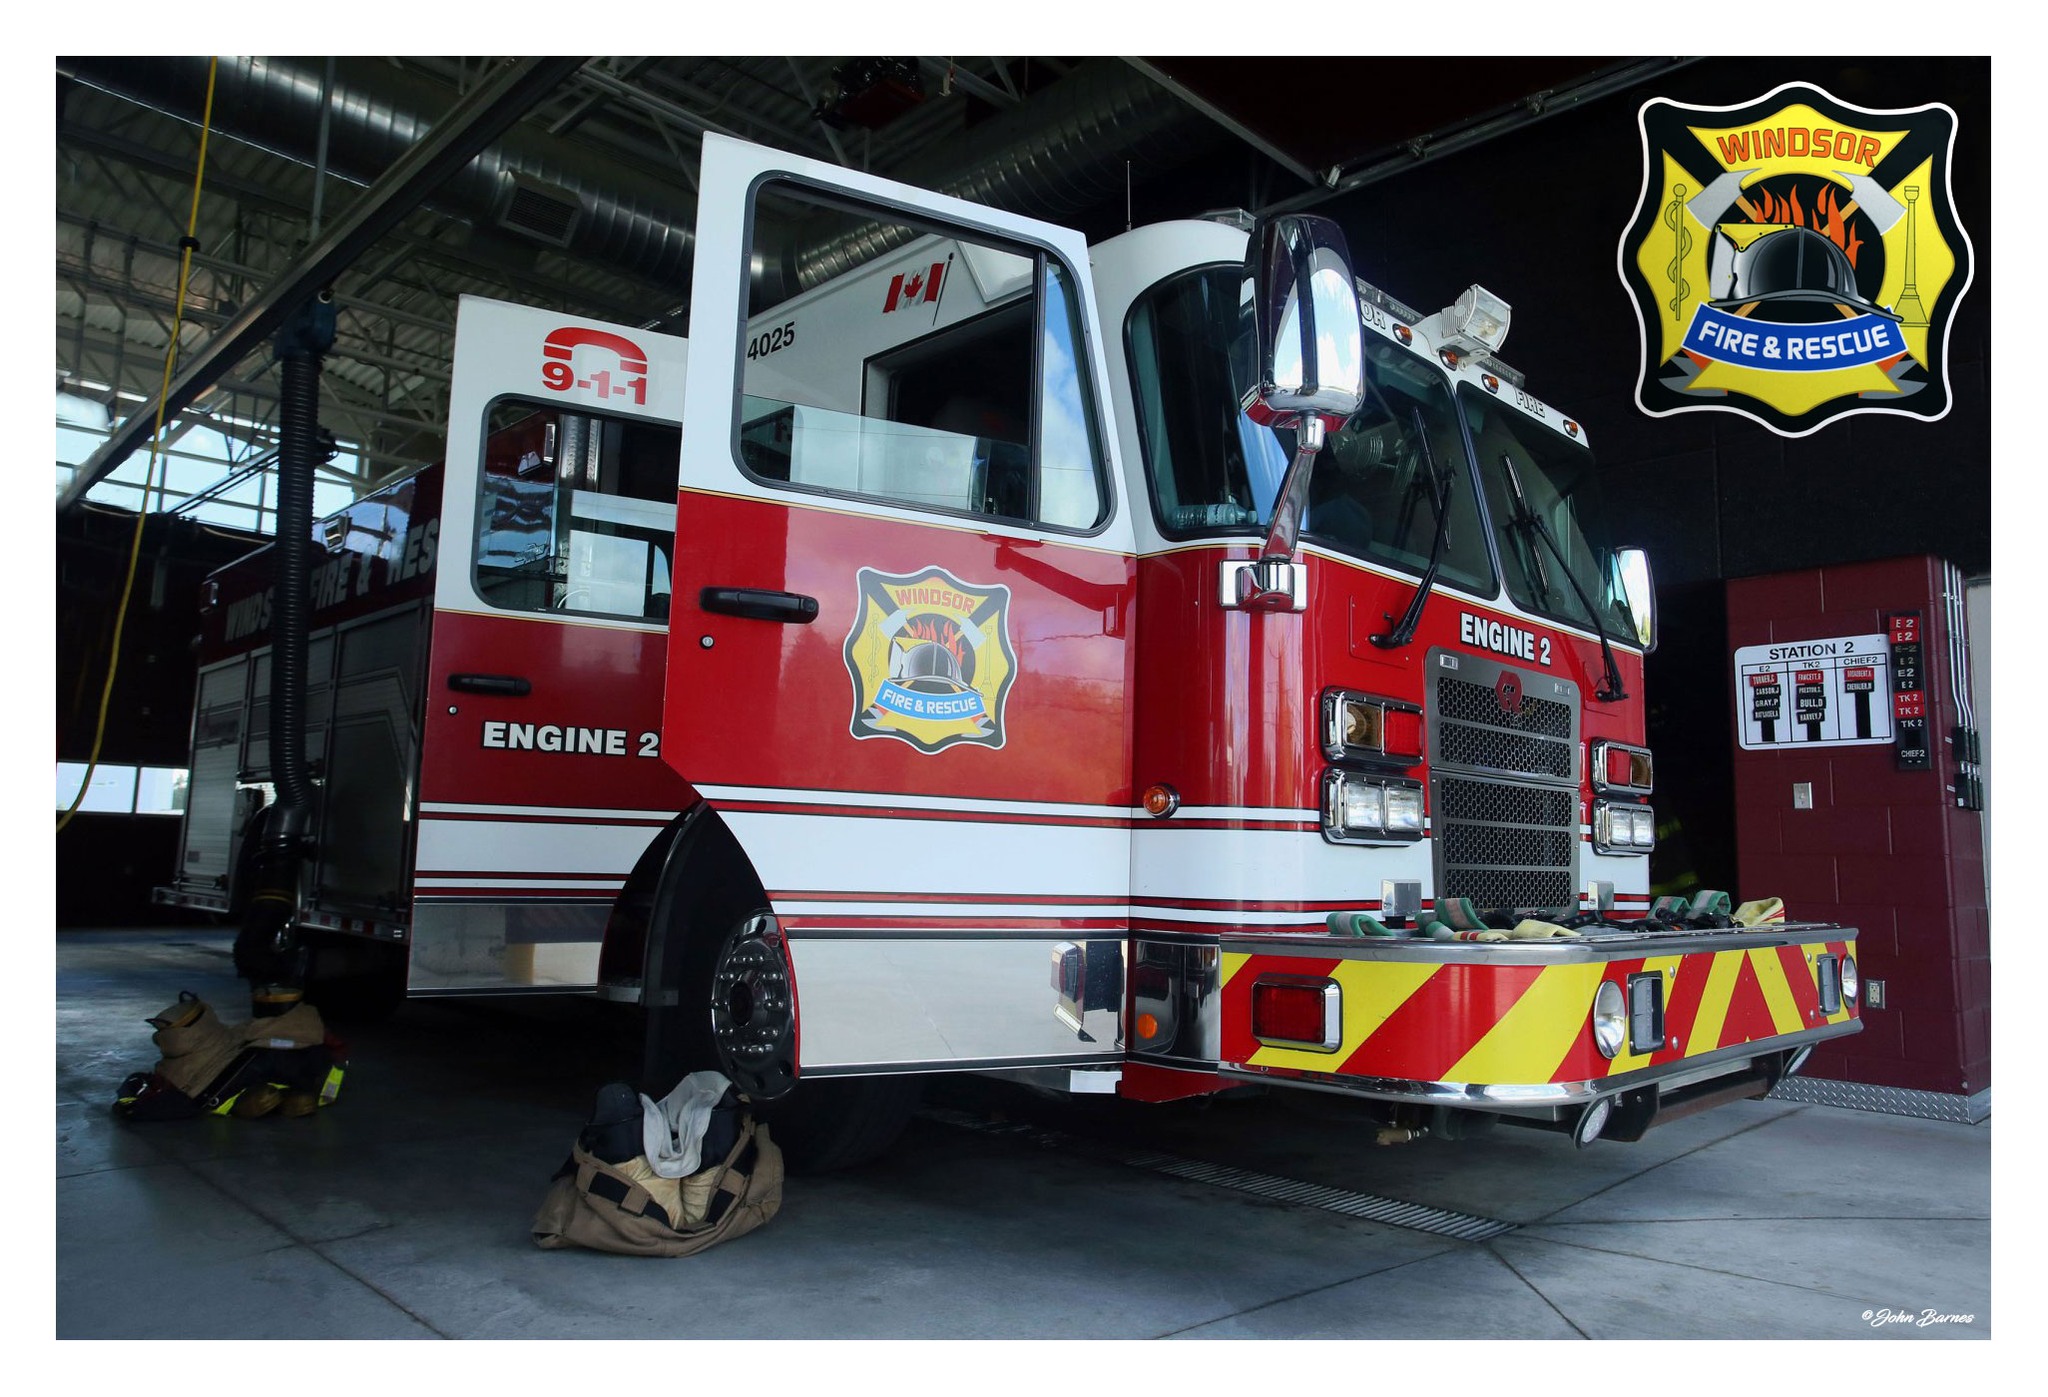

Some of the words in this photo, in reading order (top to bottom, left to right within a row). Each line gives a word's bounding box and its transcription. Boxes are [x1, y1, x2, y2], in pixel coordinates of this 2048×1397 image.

[1360, 300, 1386, 330] OR
[747, 321, 796, 361] 4025
[542, 361, 648, 406] 9-1-1
[1513, 386, 1546, 418] FIRE
[225, 585, 275, 643] WINDS
[310, 551, 354, 611] FIRE
[356, 544, 373, 597] &
[385, 517, 439, 587] RES
[895, 588, 976, 615] WINDSOR
[1459, 611, 1536, 662] ENGINE
[1540, 637, 1551, 666] 2
[1768, 642, 1837, 661] STATION
[1843, 641, 1854, 654] 2
[1759, 665, 1771, 673] E2
[882, 689, 912, 711] FIRE
[914, 700, 925, 713] &
[926, 697, 978, 715] RESCUE
[483, 720, 627, 756] ENGINE
[637, 731, 660, 759] 2
